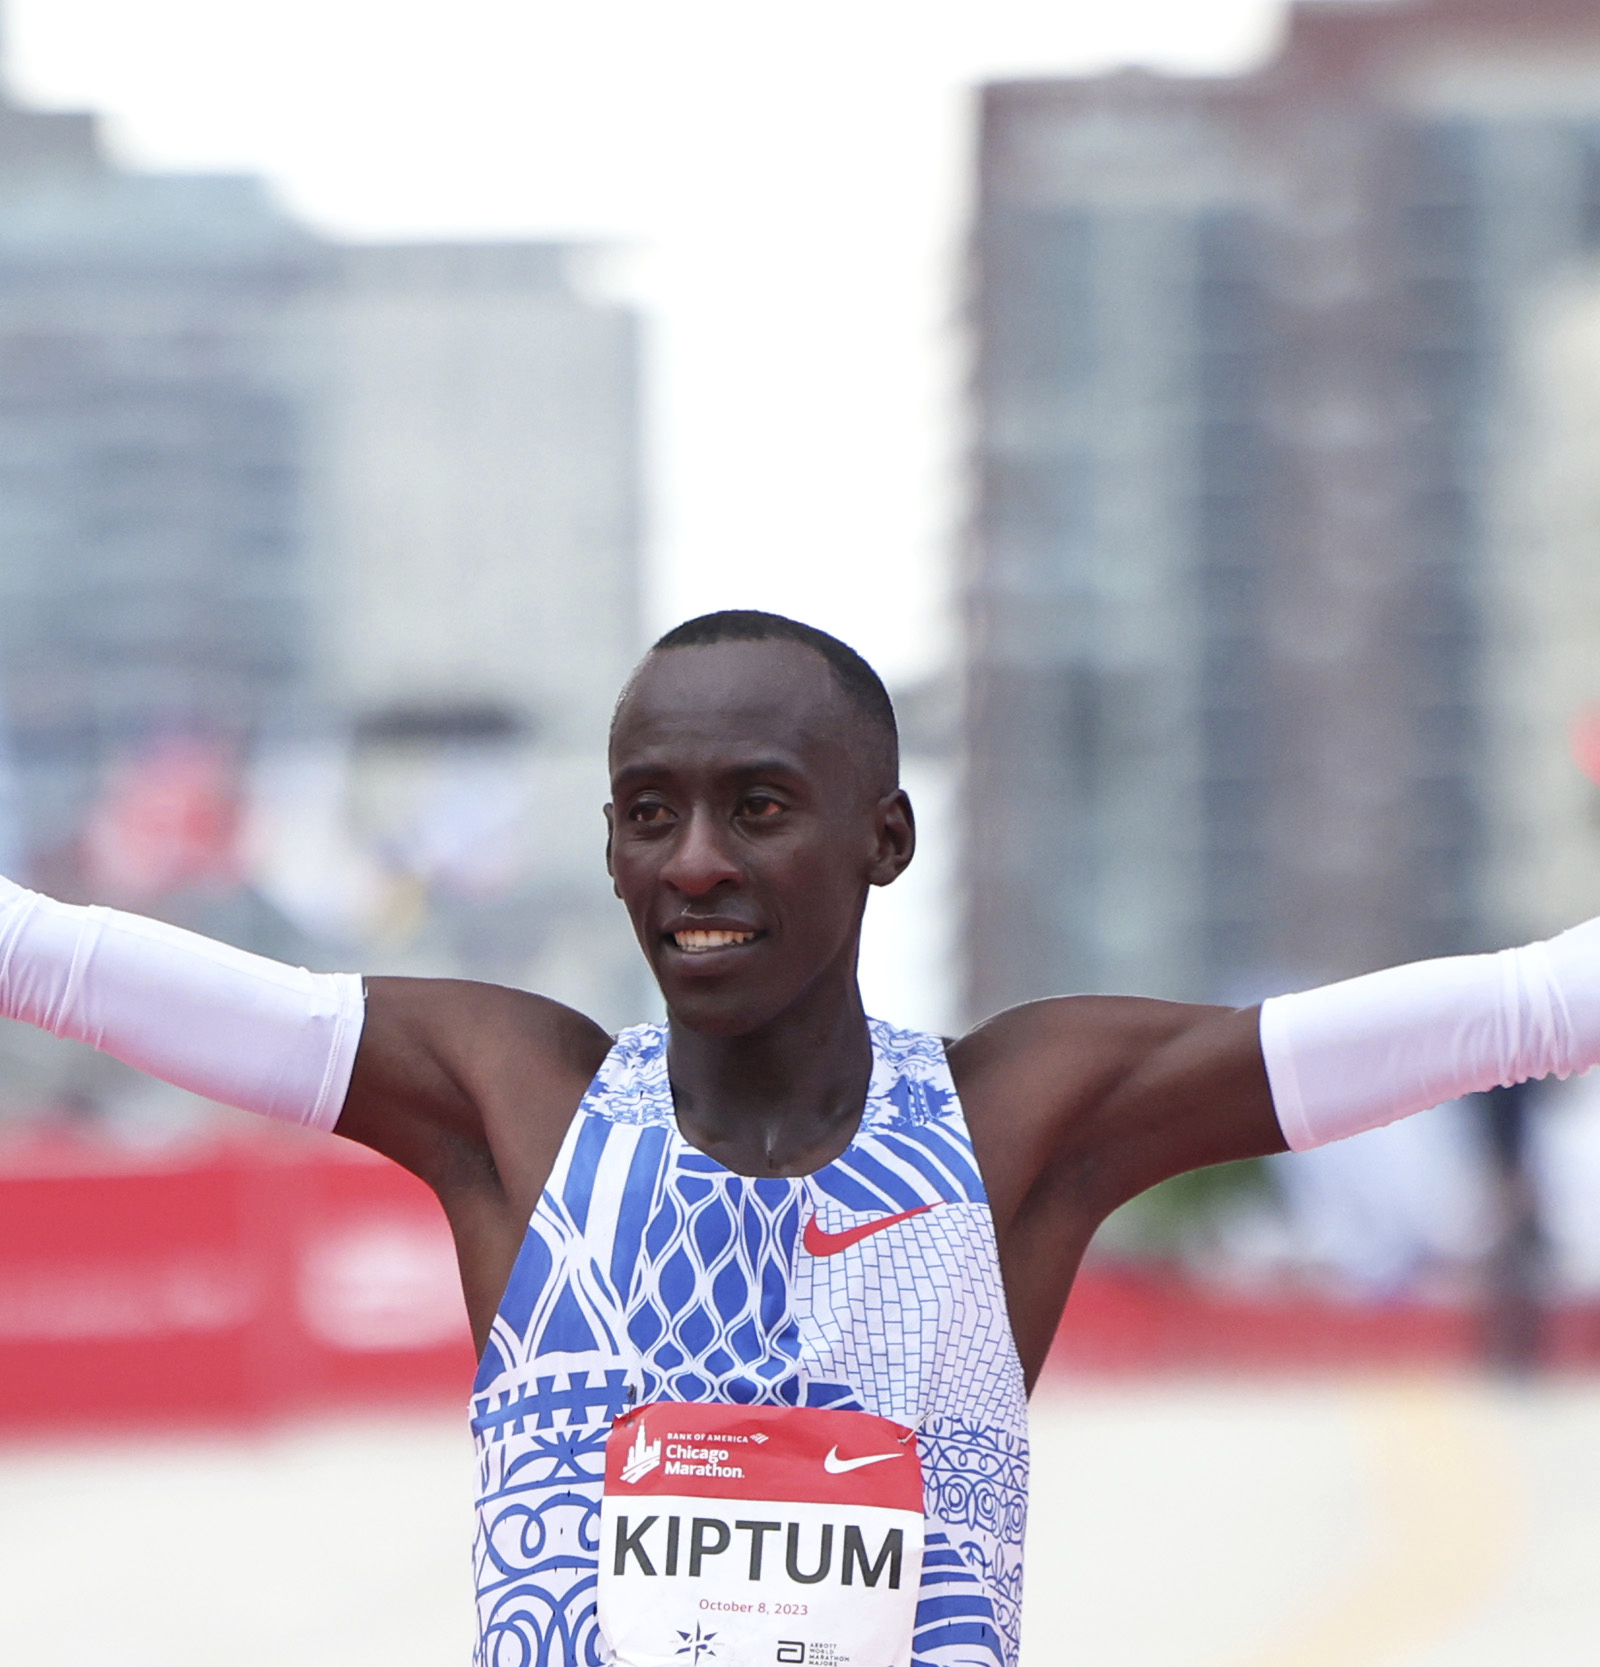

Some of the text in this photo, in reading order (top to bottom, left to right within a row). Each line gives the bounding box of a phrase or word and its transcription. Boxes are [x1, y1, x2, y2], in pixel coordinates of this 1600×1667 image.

[667, 1432, 749, 1443] BANK OF AMERICA
[665, 1444, 729, 1464] Chicago
[613, 1515, 904, 1590] KIPTUM
[699, 1598, 809, 1616] October 8, 2023
[808, 1654, 850, 1662] MARATHON
